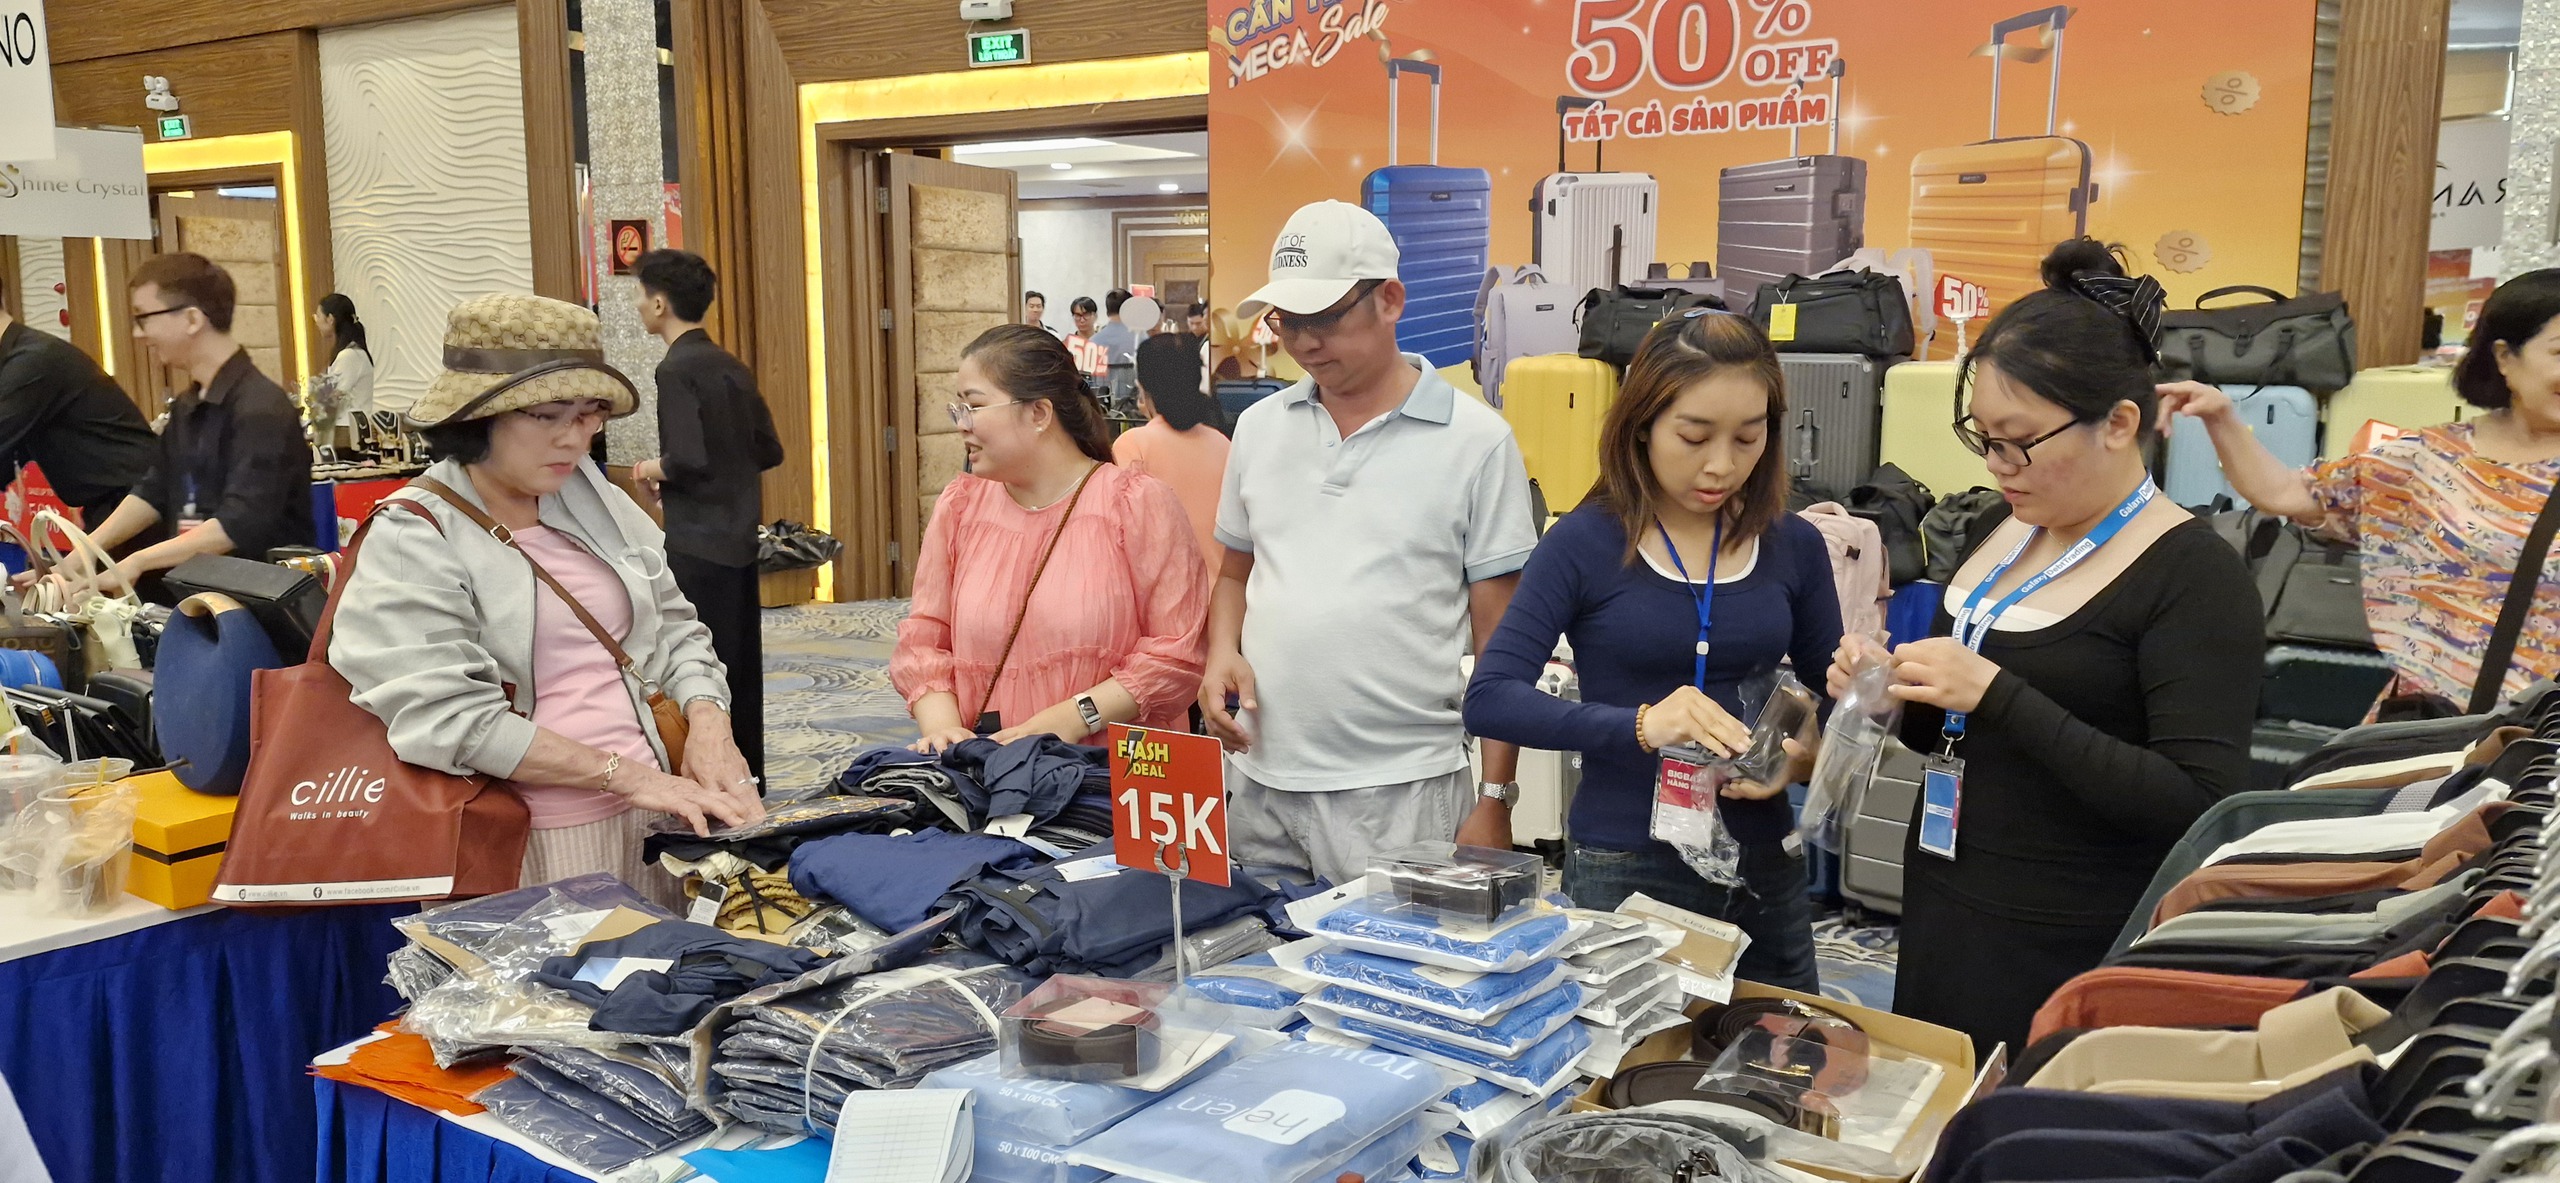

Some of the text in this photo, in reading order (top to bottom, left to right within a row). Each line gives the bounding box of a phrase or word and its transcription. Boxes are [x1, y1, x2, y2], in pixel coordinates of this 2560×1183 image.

[980, 35, 1013, 50] EXIT
[1227, 0, 1389, 89] MEGA Sale
[1744, 43, 1833, 82] OFF
[1565, 87, 1826, 139] TẤT CẢ SẢN PHẨM
[76, 177, 144, 199] Crystal
[1290, 234, 1306, 247] OF
[2118, 494, 2146, 518] Galaxy
[2021, 574, 2048, 593] Galaxy
[1117, 739, 1170, 763] FASH
[1133, 762, 1167, 778] DEAL
[290, 765, 386, 806] cillie
[289, 809, 369, 821] Walks in beauty
[1118, 787, 1223, 855] 15K
[999, 1086, 1014, 1097] 50
[1022, 1093, 1042, 1104] 100
[1176, 1095, 1310, 1136] helen
[998, 1141, 1012, 1154] 50
[1012, 1146, 1020, 1156] x
[1020, 1146, 1041, 1160] 100
